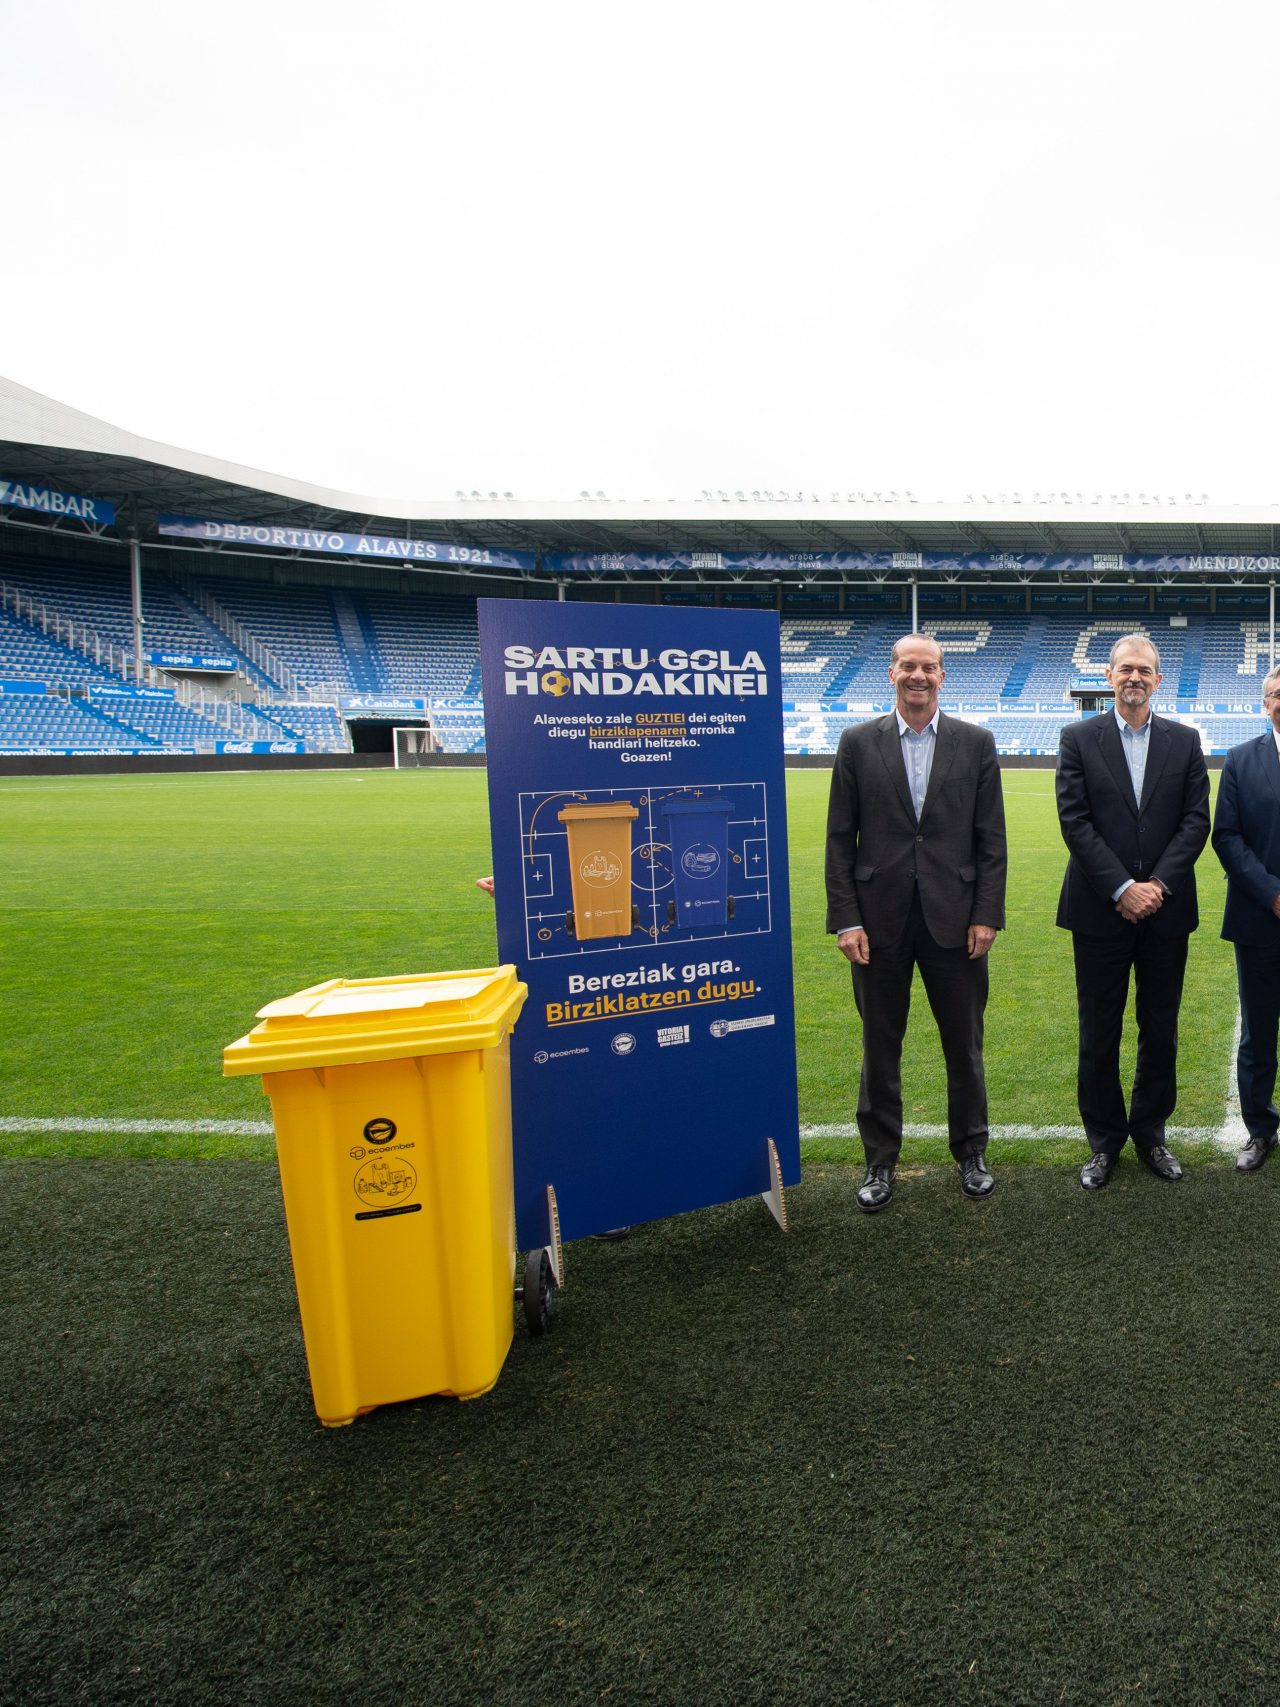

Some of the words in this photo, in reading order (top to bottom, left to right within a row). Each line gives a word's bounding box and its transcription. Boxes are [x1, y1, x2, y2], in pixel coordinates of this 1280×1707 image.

[10, 484, 98, 520] AMBAR
[204, 521, 344, 550] DEPORTIVO
[357, 537, 437, 559] ALAVÉS
[449, 547, 493, 564] 1921
[504, 645, 648, 670] SARTU
[659, 649, 766, 672] GOLA
[365, 700, 416, 709] CaixaBank
[447, 700, 483, 709] CaixaBa
[1152, 704, 1177, 713] IMQ
[1190, 704, 1215, 713] IMQ
[1228, 704, 1253, 713] IMQ
[533, 714, 602, 725] Alaveseko
[606, 714, 632, 724] zale
[635, 713, 685, 724] GUZTIEI
[688, 712, 707, 723] dei
[709, 712, 746, 726] egiten
[548, 726, 586, 740] diegu
[589, 726, 687, 738] birziklapenaren
[690, 725, 735, 735] erronka
[589, 738, 642, 750] handiari
[645, 736, 701, 748] heltzeko.
[620, 752, 673, 763] Goazen!
[569, 963, 676, 994] Bereziak
[682, 959, 741, 983] gara.
[546, 988, 690, 1023] Birziklatzen
[697, 979, 762, 1001] dugu.
[657, 1027, 683, 1037] VITORIA
[550, 1047, 590, 1058] ecoembes
[368, 1142, 415, 1155] ecoembes
